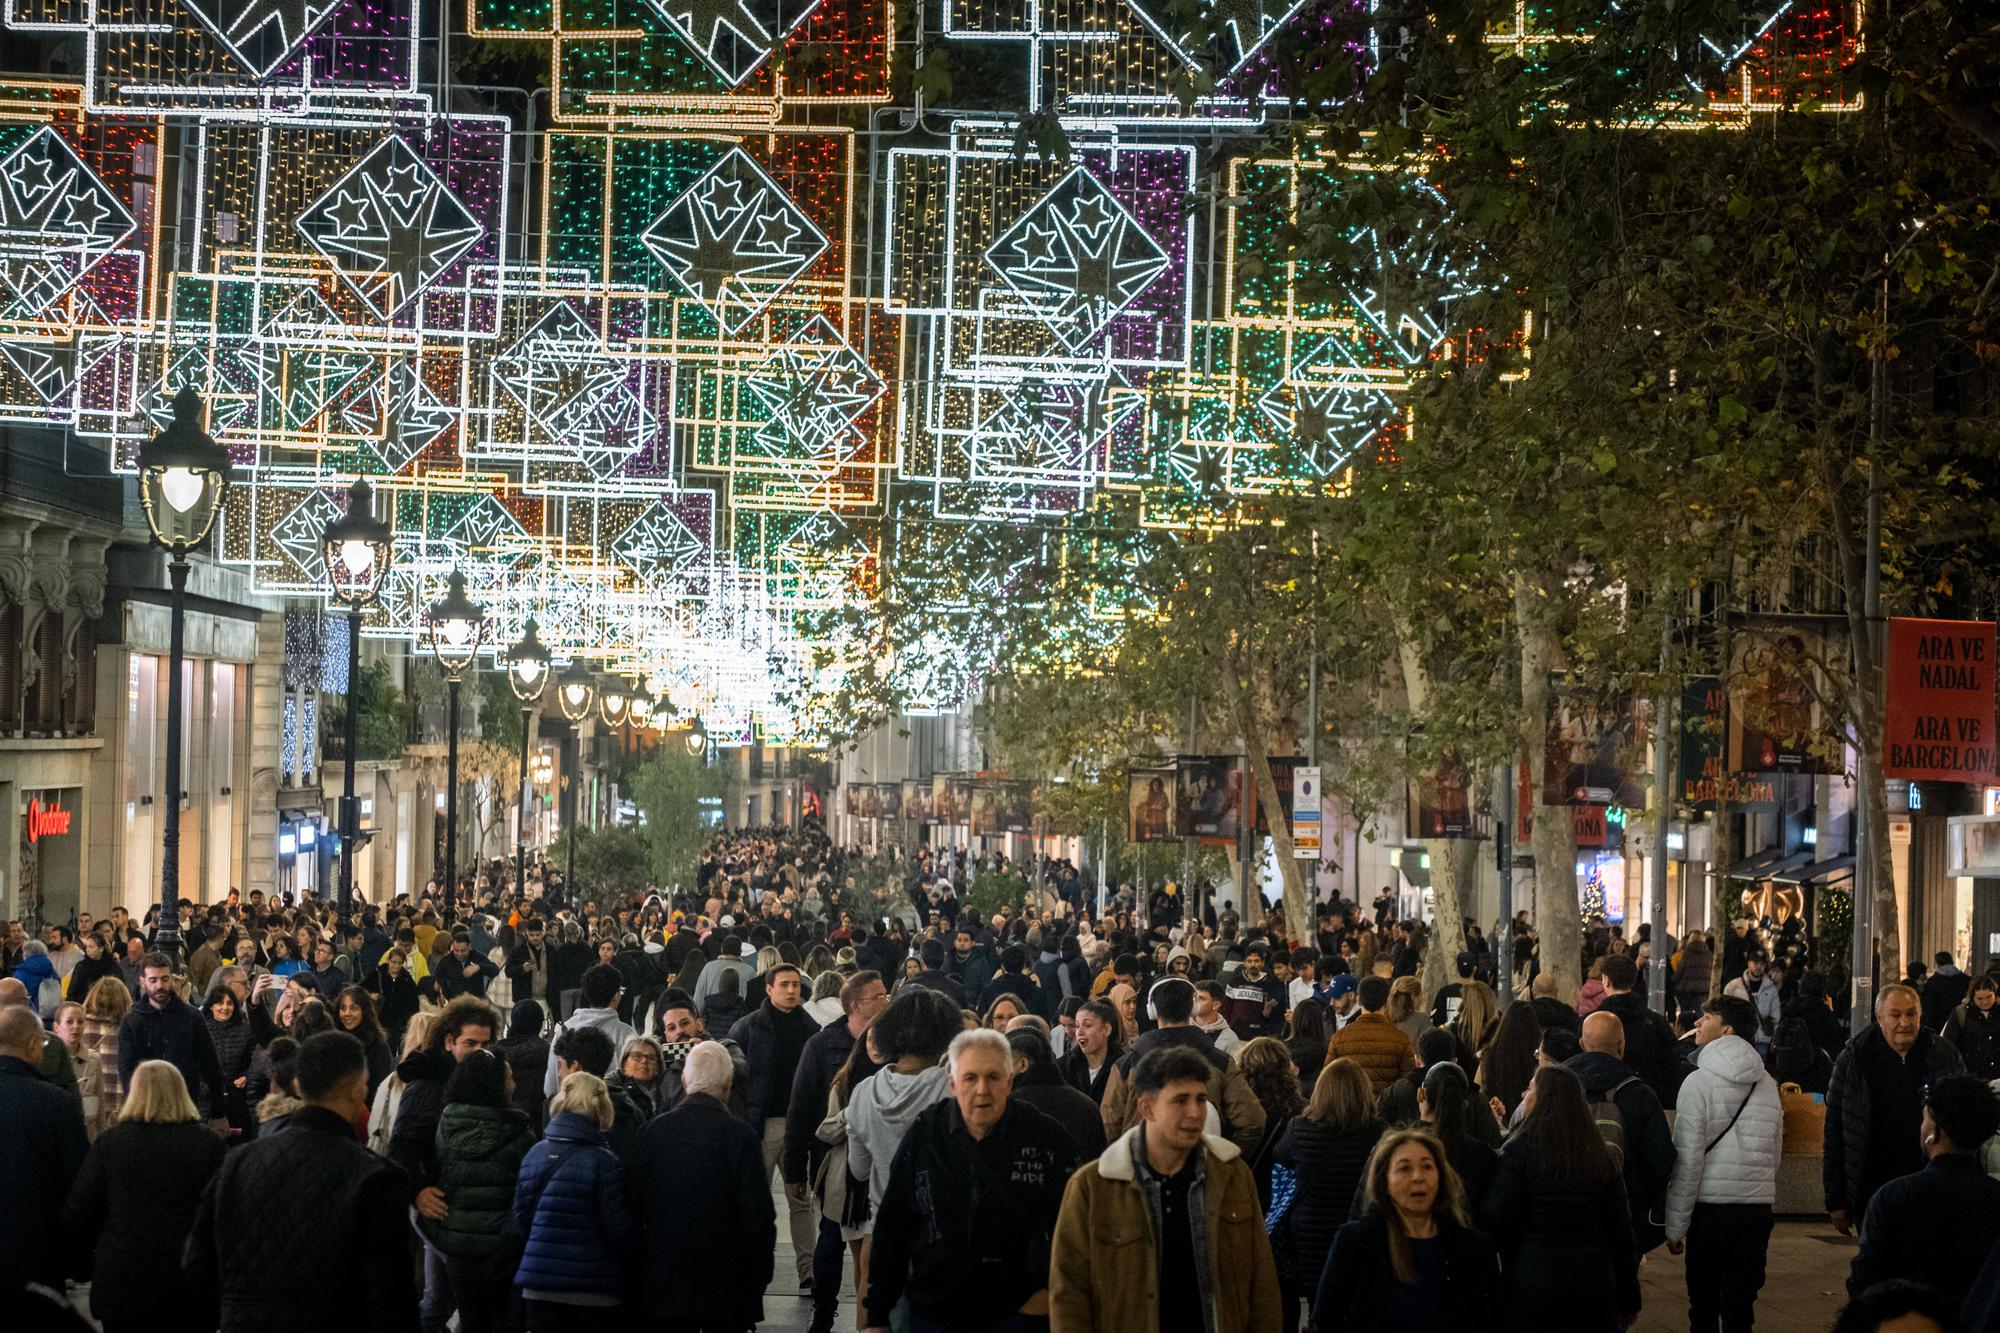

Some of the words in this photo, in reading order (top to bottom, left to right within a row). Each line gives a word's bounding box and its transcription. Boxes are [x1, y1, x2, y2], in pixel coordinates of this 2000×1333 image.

[1917, 636, 1954, 660] ARA
[1961, 637, 1985, 662] VE
[1919, 664, 1982, 690] NADAL
[1913, 716, 1952, 741] ARA
[1956, 718, 1980, 742] VE
